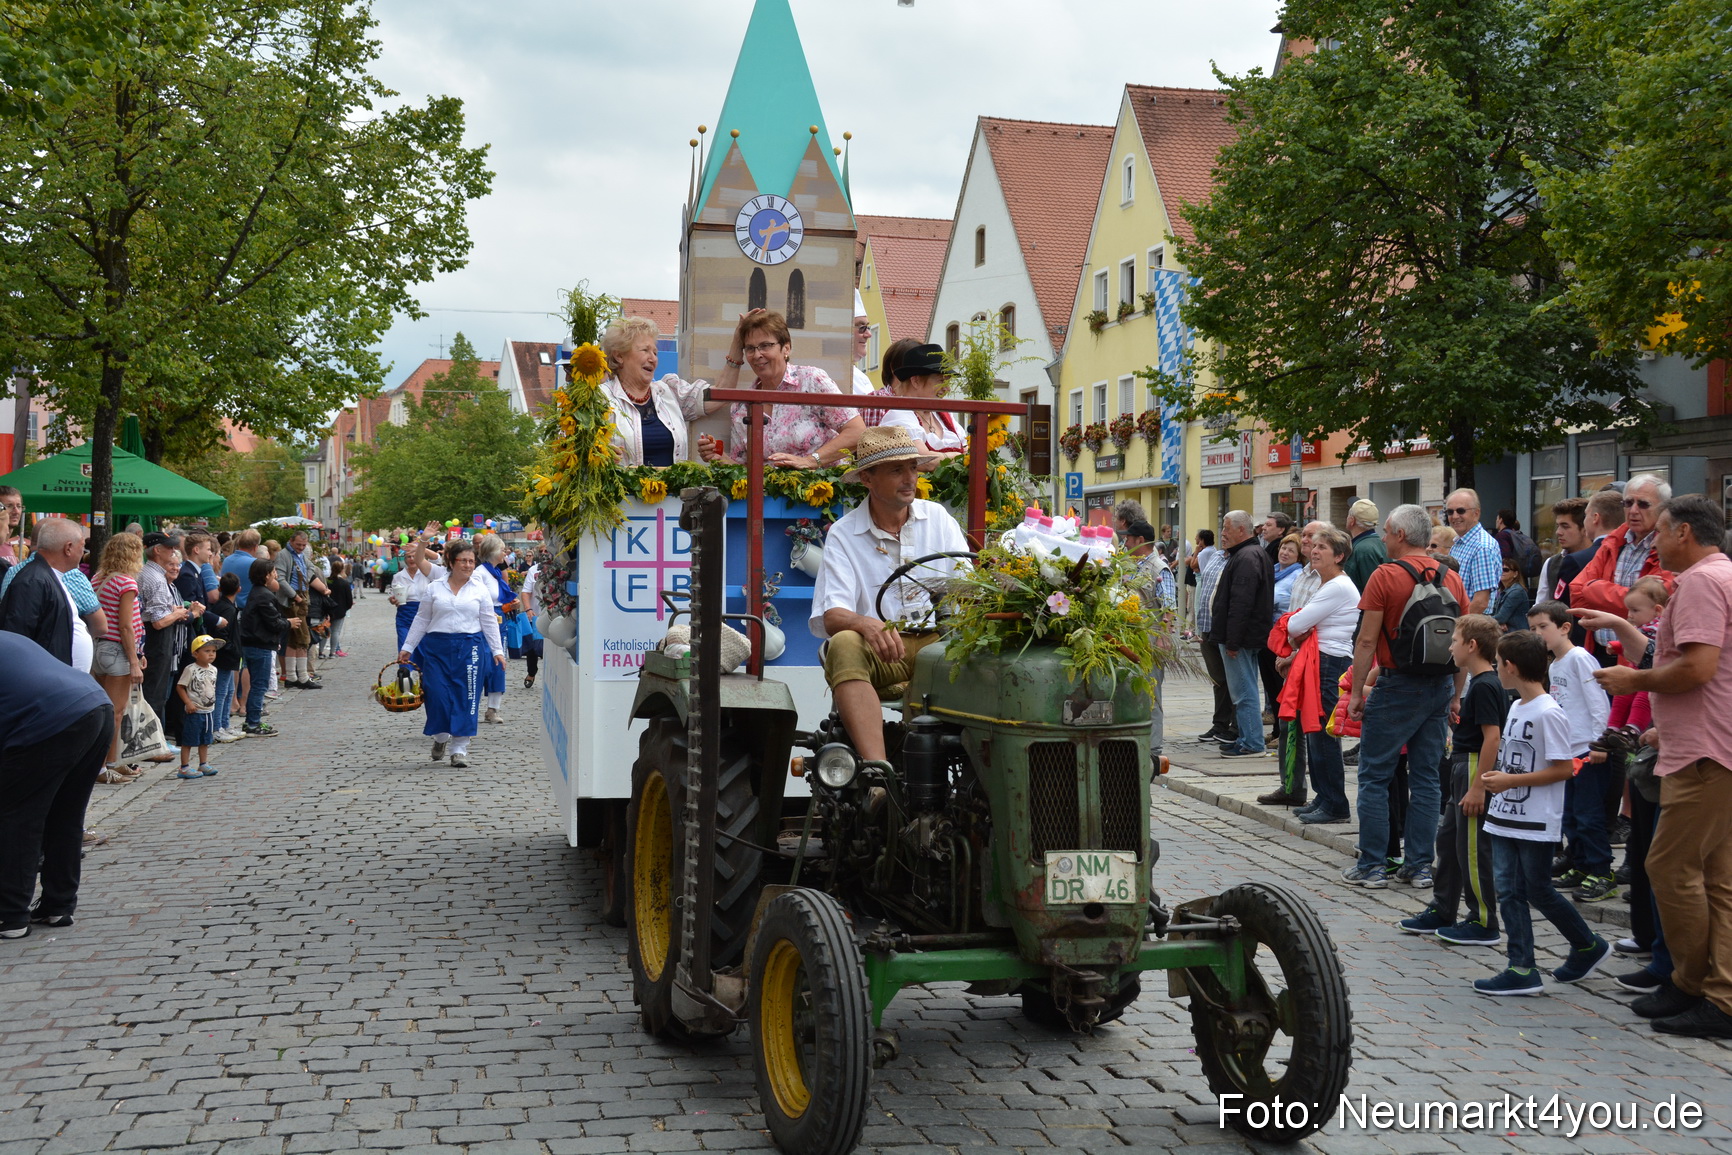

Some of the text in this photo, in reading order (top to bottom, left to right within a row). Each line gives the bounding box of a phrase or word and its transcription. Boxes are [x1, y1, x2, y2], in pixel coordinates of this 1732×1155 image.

[1224, 452, 1234, 462] KINO
[1069, 476, 1080, 496] P
[1076, 855, 1110, 876] NM
[1052, 878, 1128, 900] DR 46
